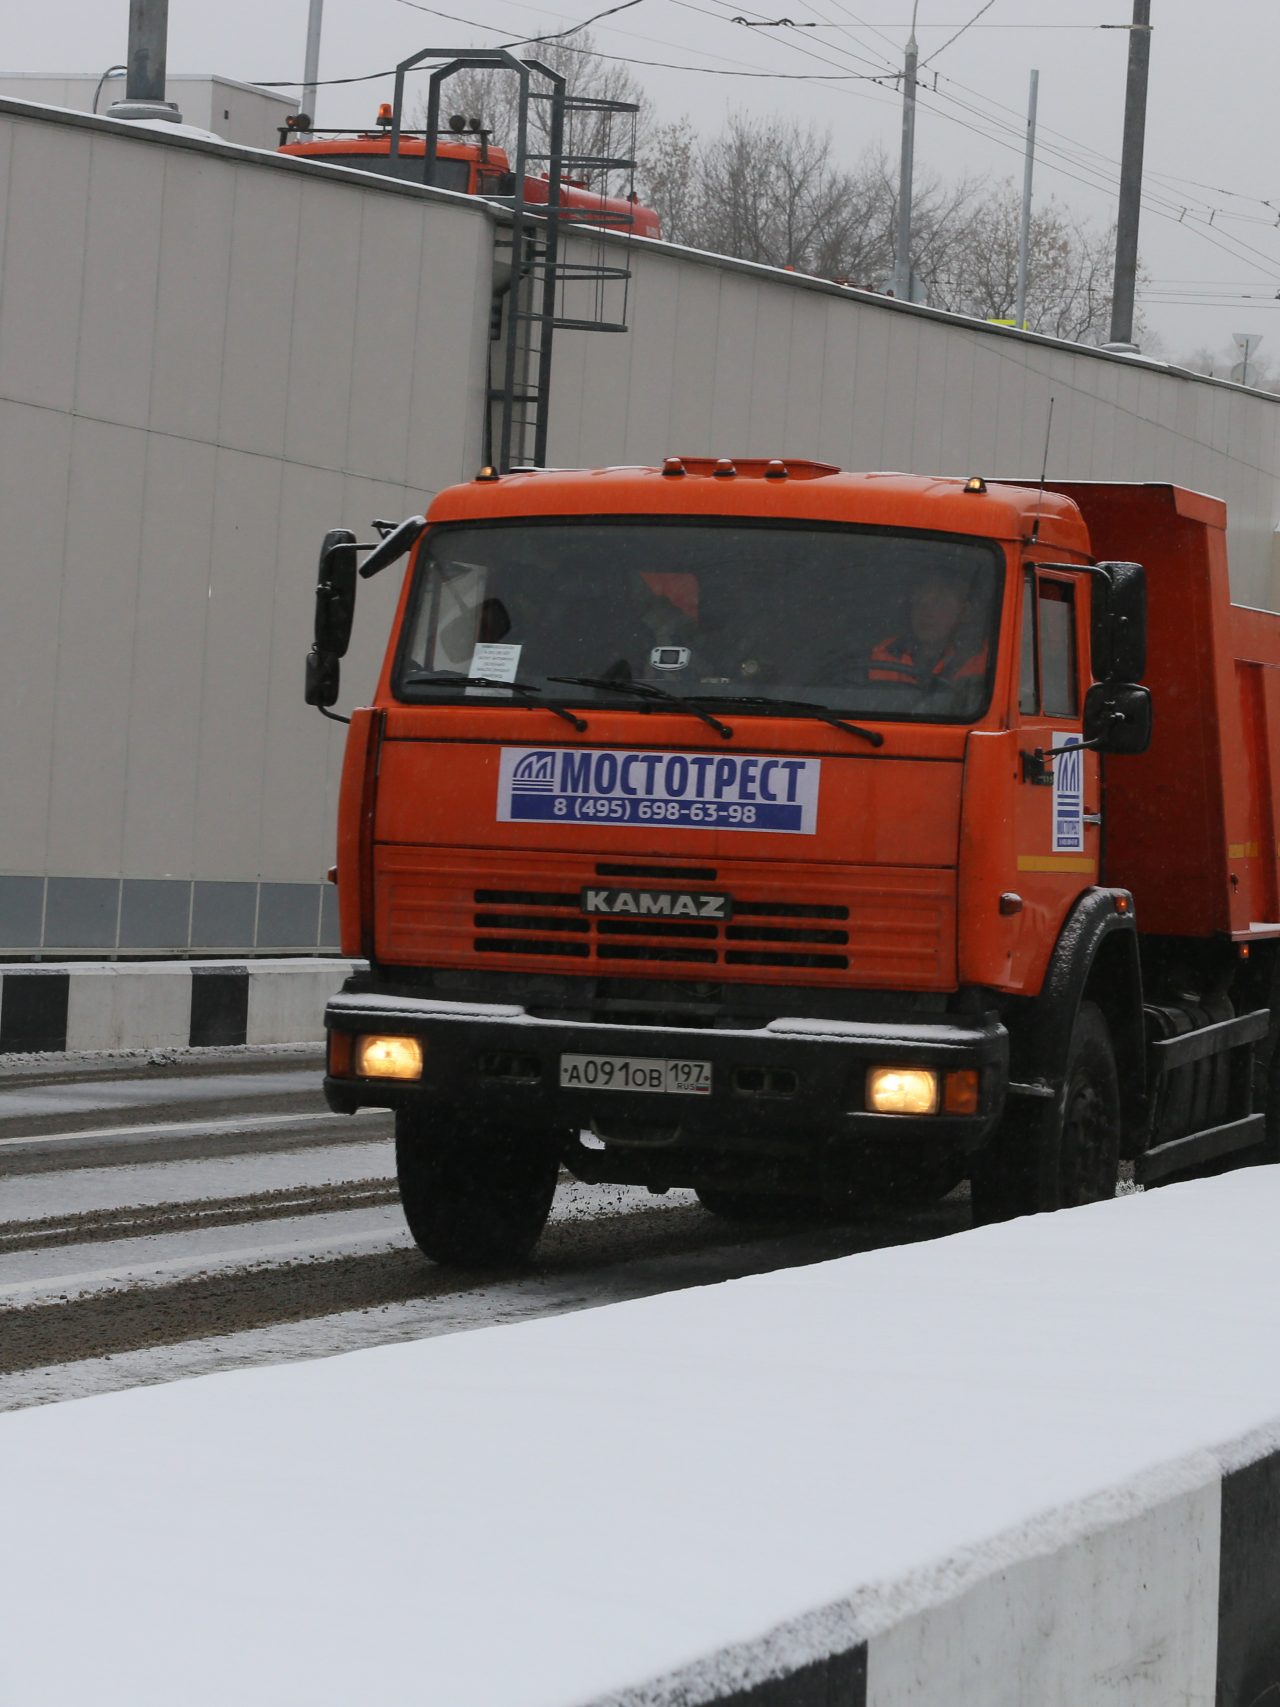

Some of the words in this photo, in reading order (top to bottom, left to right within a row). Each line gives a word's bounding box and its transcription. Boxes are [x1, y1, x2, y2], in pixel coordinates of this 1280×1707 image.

[560, 752, 806, 802] МОСТОТРЕСТ
[553, 798, 567, 815] 8
[574, 798, 631, 820] (495)
[638, 801, 756, 823] 698-63-98
[587, 891, 725, 918] KAMAZ
[669, 1063, 705, 1083] 197
